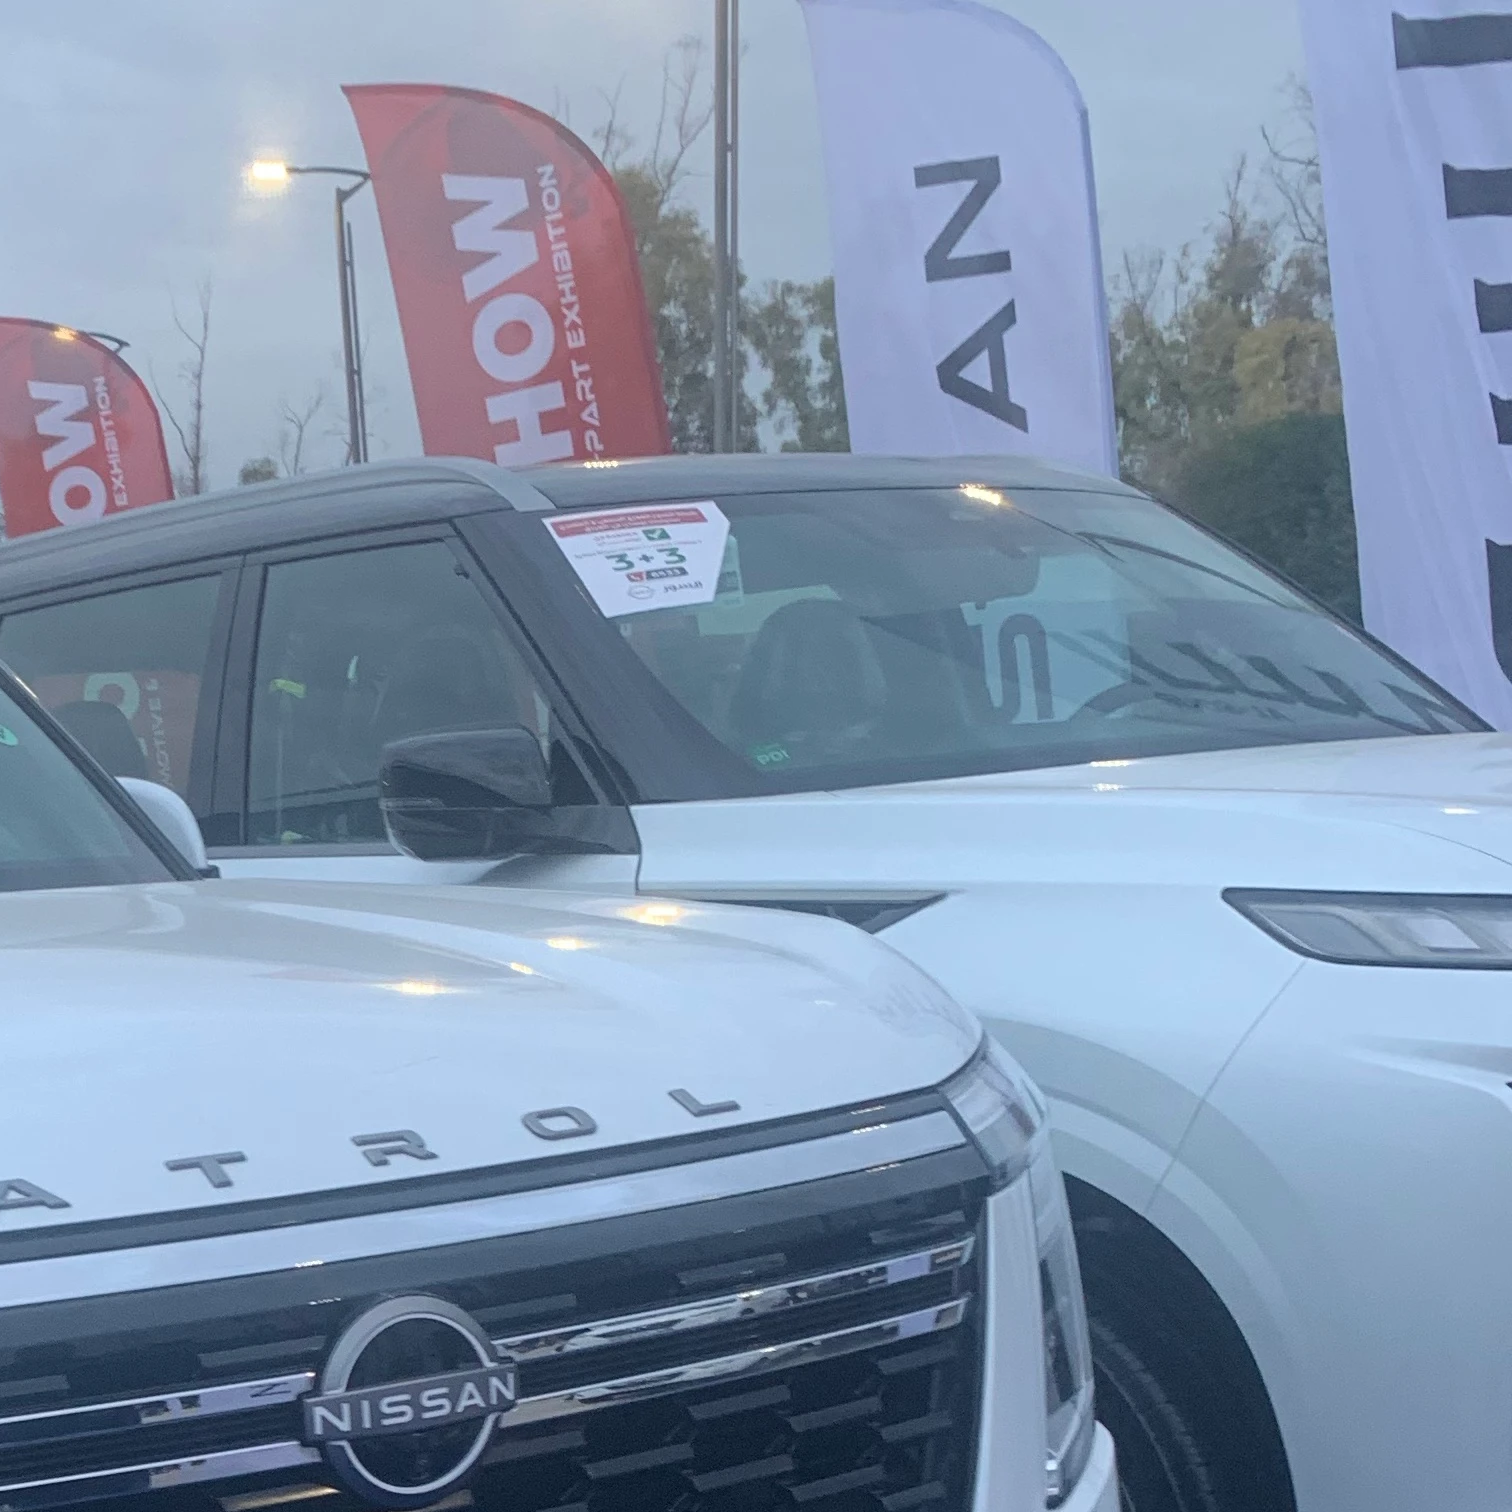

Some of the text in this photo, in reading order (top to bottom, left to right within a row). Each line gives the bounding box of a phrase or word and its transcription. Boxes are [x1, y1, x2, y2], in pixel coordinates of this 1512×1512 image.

[441, 173, 575, 468] HOW
[536, 163, 587, 349] EXHIBITION
[26, 379, 108, 528] OW
[93, 375, 129, 507] EXHIBITION
[312, 1371, 516, 1436] NISSAN
